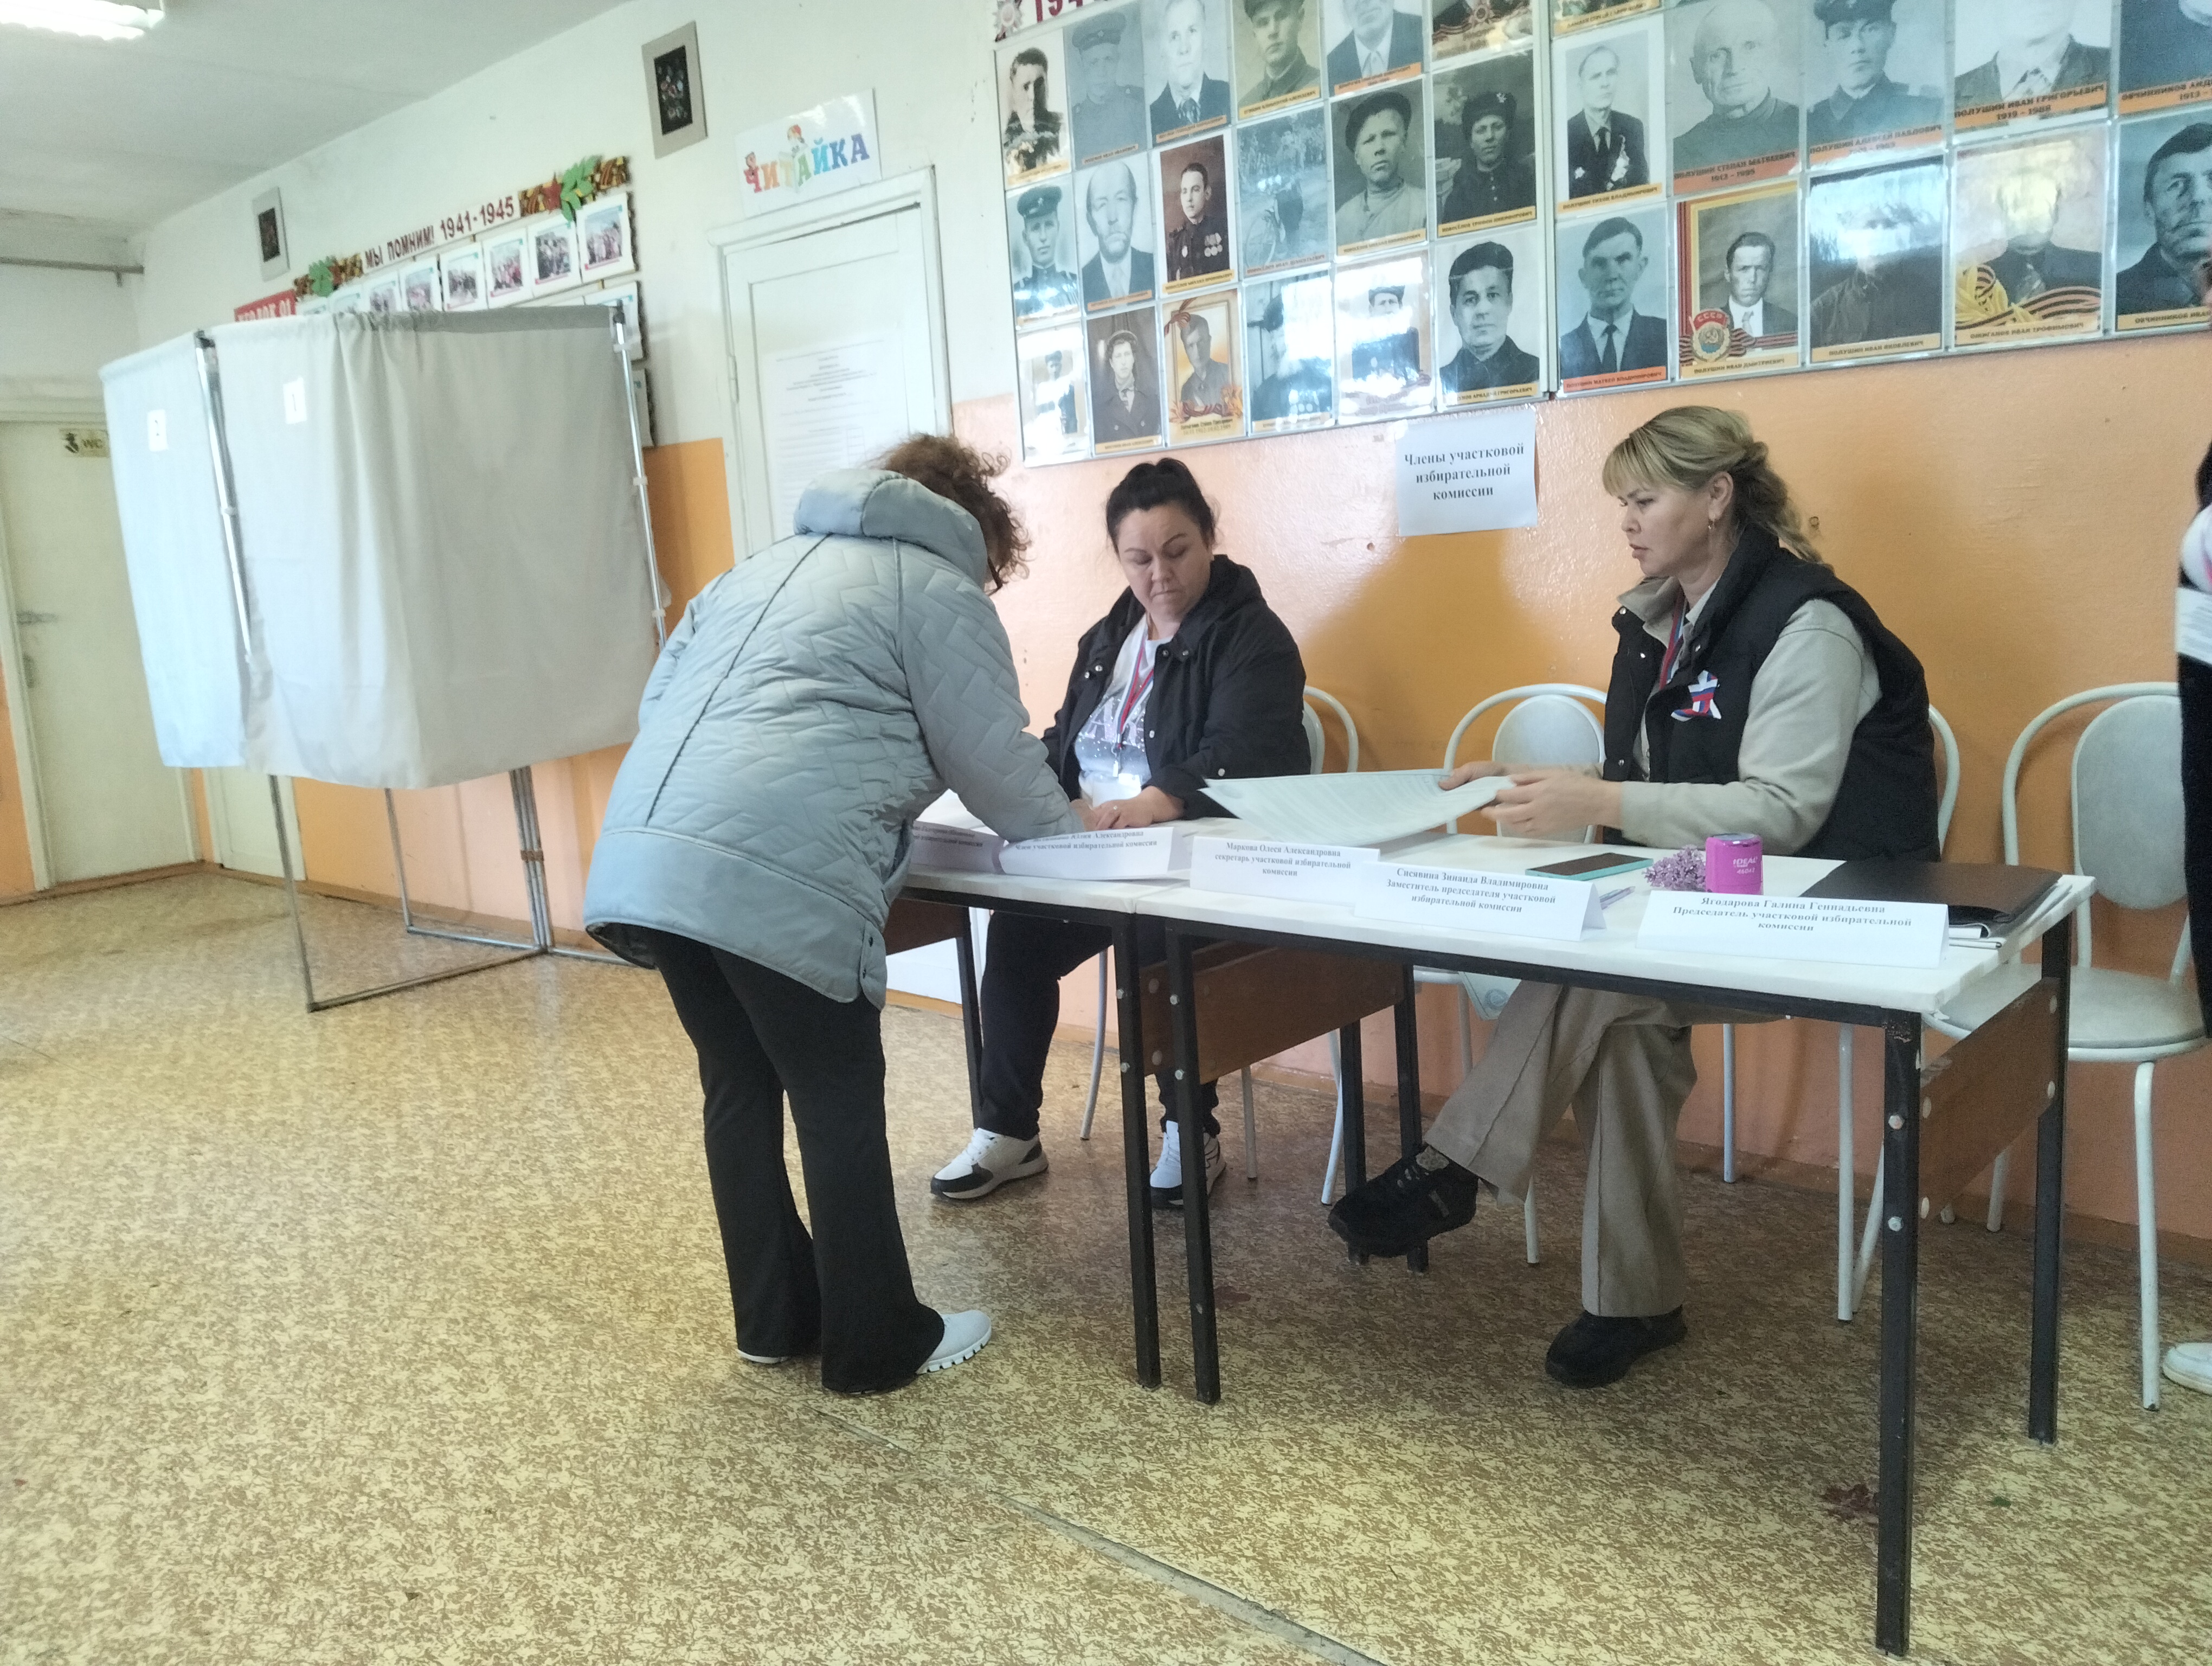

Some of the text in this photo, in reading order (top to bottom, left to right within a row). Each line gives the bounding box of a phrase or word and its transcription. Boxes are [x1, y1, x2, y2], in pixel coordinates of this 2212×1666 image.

[1954, 102, 2005, 118] ПОЛУШИН
[2008, 97, 2035, 108] ИВАН
[744, 133, 870, 194] ЧИТАЙКА
[365, 195, 515, 268] МЫ ПОМНИМ! 1941-1945
[1697, 311, 1723, 323] СССР
[2011, 326, 2030, 335] ИВАН
[1864, 344, 1882, 353] ИВАН
[1404, 442, 1525, 466] Члены участковой
[1416, 463, 1511, 484] избирательной
[1433, 486, 1494, 501] комиссии
[1095, 831, 1144, 840] Александровна
[1032, 842, 1071, 850] участковой
[1073, 841, 1124, 851] избирательной
[1226, 842, 1341, 857] Маркова Олеся Александровна
[1214, 854, 1351, 869] секретарь участковой избирательной
[1262, 868, 1298, 876] комиссии
[1397, 867, 1549, 891] Сисявина Зинаида Владимировна
[1386, 879, 1556, 904] Заместитель председателя участковой
[1411, 895, 1523, 913] избирательной комиссии
[1700, 896, 1886, 914] Ягодарова Галина Геннадьевна
[1672, 906, 1912, 927] Председатель участковой избирательной
[1758, 922, 1814, 931] комиссии
